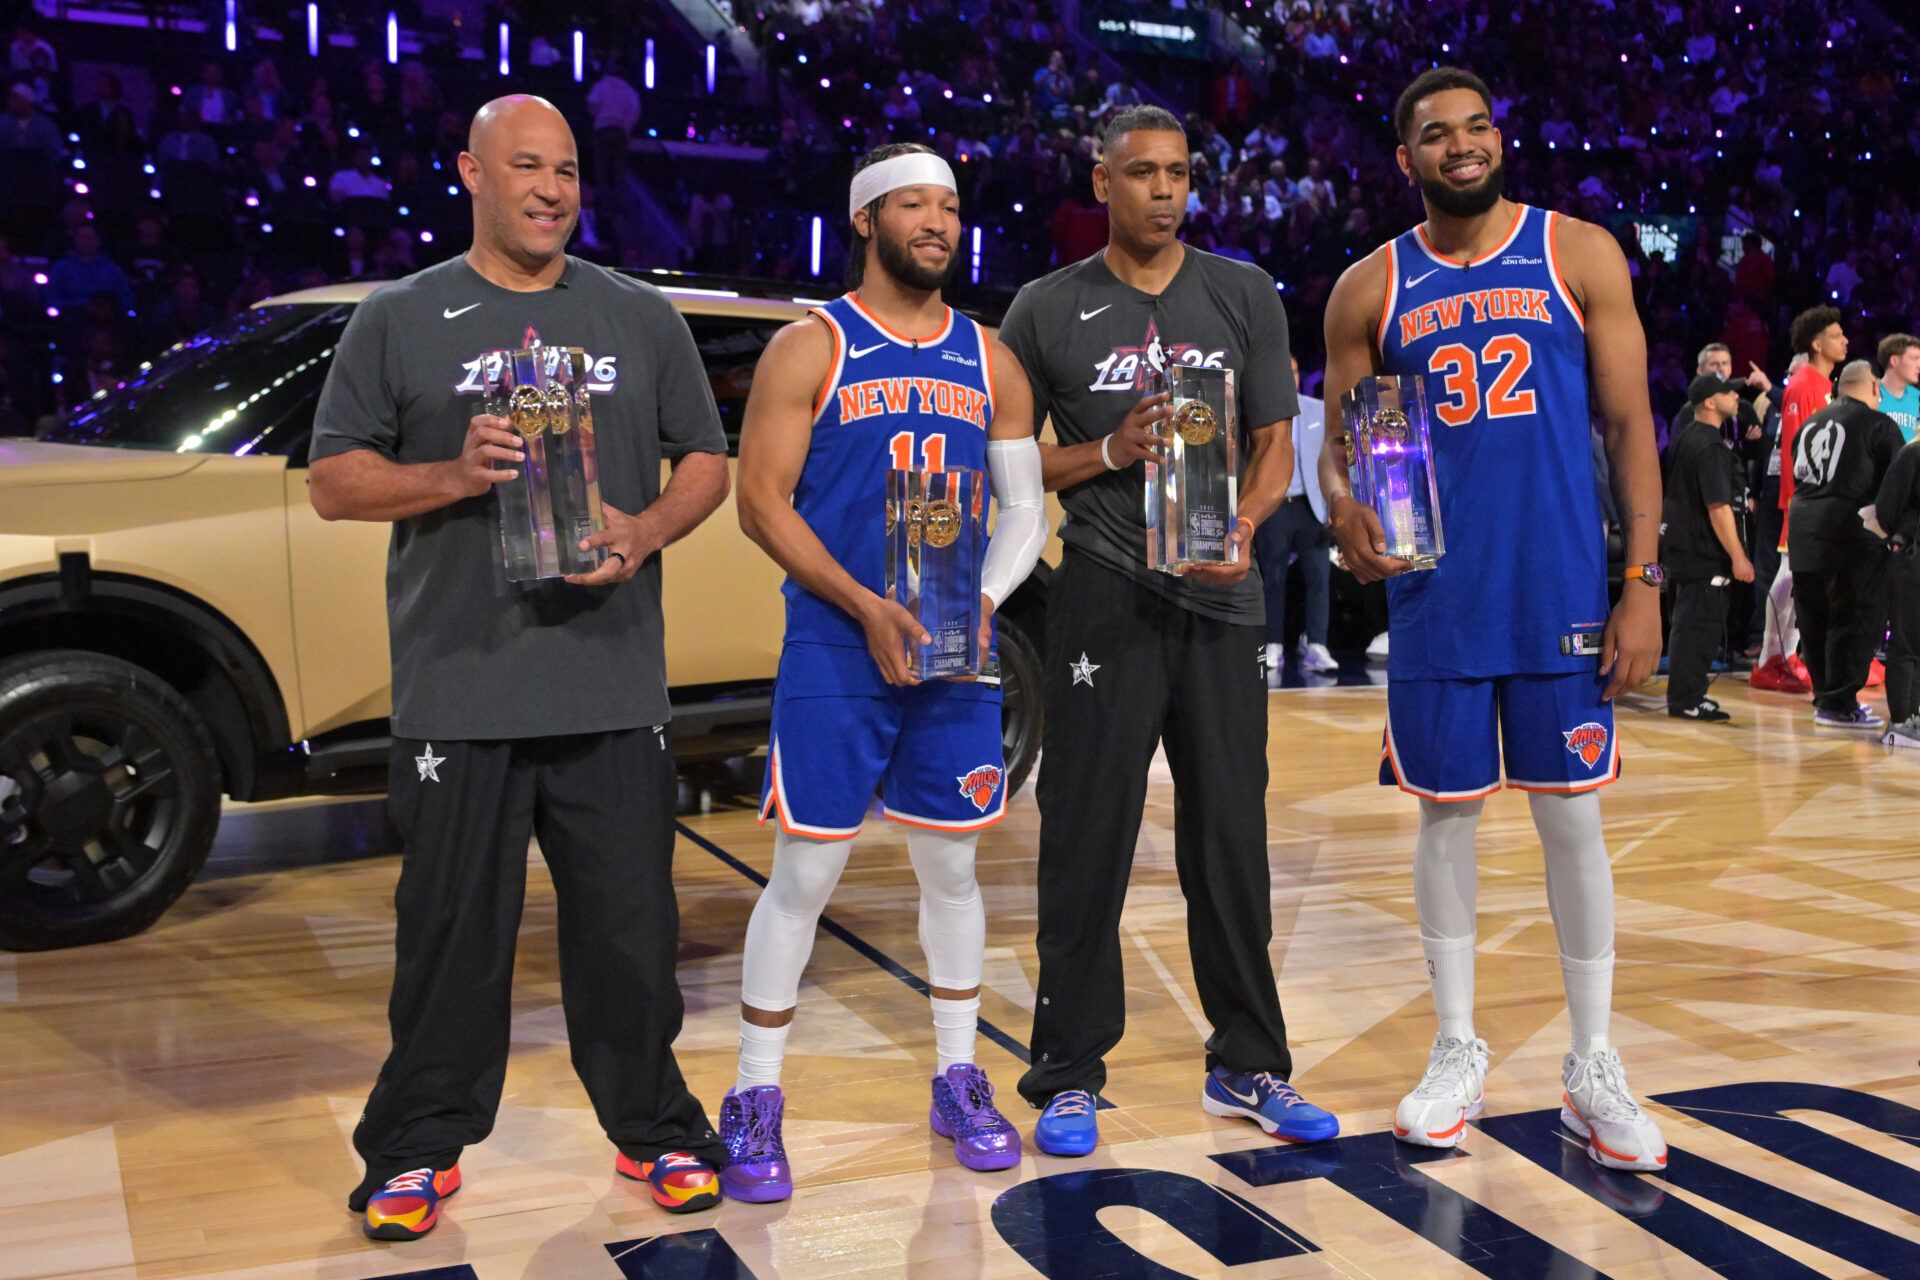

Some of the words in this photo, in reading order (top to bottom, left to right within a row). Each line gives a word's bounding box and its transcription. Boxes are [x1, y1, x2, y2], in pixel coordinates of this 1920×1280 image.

[1399, 294, 1465, 348] NEW
[1466, 287, 1553, 324] YORK
[837, 376, 912, 426] NEW
[912, 376, 988, 431] YORK
[1427, 333, 1537, 427] 32
[889, 430, 947, 474] 11
[934, 656, 966, 669] CHAMPIONS
